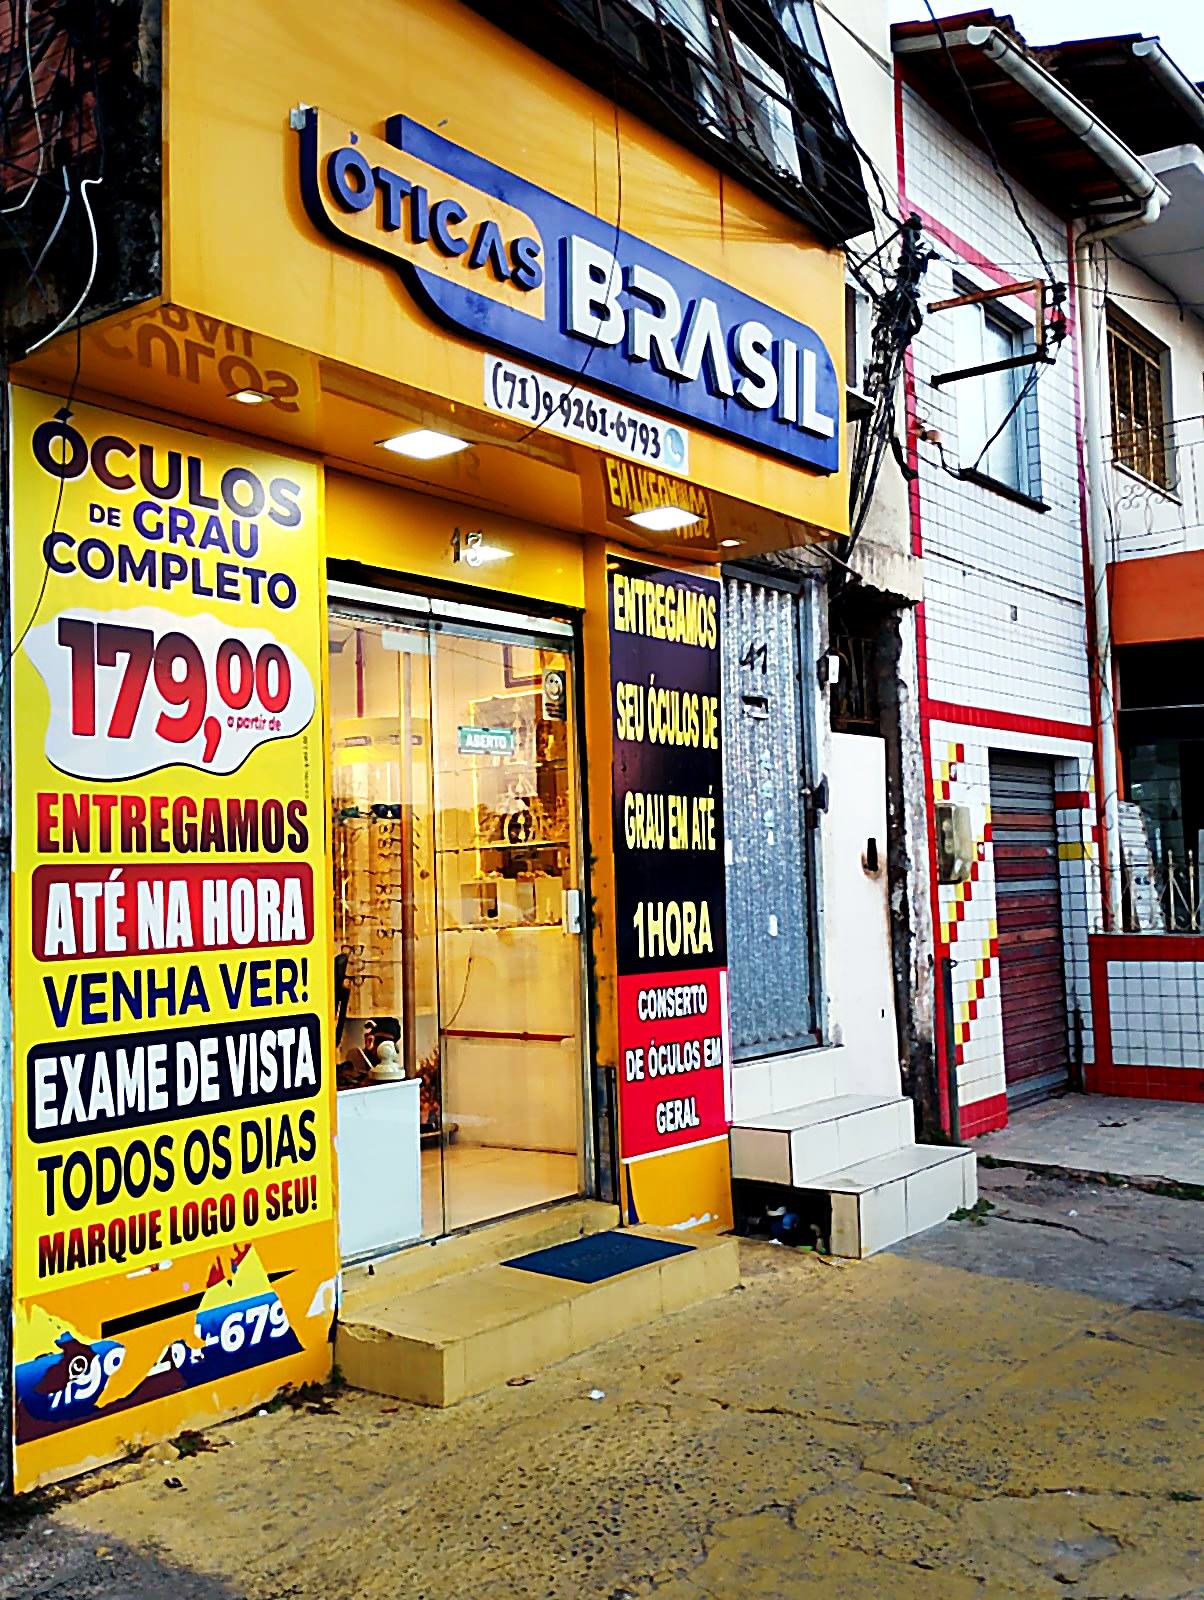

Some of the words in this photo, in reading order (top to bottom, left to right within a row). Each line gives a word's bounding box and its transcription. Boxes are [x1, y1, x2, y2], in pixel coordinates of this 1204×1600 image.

[327, 131, 544, 291] ÓTICAS
[560, 233, 834, 439] BRASIL
[32, 407, 302, 527] ÓCULOS
[89, 503, 121, 528] DE
[133, 500, 259, 558] GRAU
[42, 531, 297, 609] COMPLETO
[613, 573, 717, 650] ENTREGAMOS
[57, 617, 292, 764] 179,00
[268, 715, 282, 731] de
[616, 681, 645, 743] SEU
[647, 673, 700, 749] ÓCULOS
[702, 696, 719, 750] DE
[36, 792, 310, 854] ENTREGAMOS
[624, 790, 665, 850] GRAU
[668, 794, 689, 850] EM
[692, 785, 716, 851] ATÉ
[44, 867, 127, 956] ATÉ
[136, 879, 194, 950] NA
[202, 877, 307, 946] HORA
[42, 965, 211, 1028] VENHA
[219, 957, 309, 1010] VER!
[637, 983, 708, 1021] CONSERTO
[34, 1043, 169, 1130] EXAME
[176, 1037, 220, 1107] DE
[225, 1026, 317, 1098] VISTA
[625, 1047, 645, 1082] DE
[647, 1039, 700, 1078] ÓCULOS
[703, 1037, 722, 1067] EM
[655, 1096, 700, 1134] GERAL
[38, 1134, 175, 1217] TODOS
[183, 1125, 232, 1186] OS
[240, 1109, 317, 1175] DIAS
[38, 1209, 162, 1279] MARQUE
[169, 1193, 236, 1245] LOGO
[243, 1188, 259, 1227] O
[265, 1174, 318, 1221] SEU!
